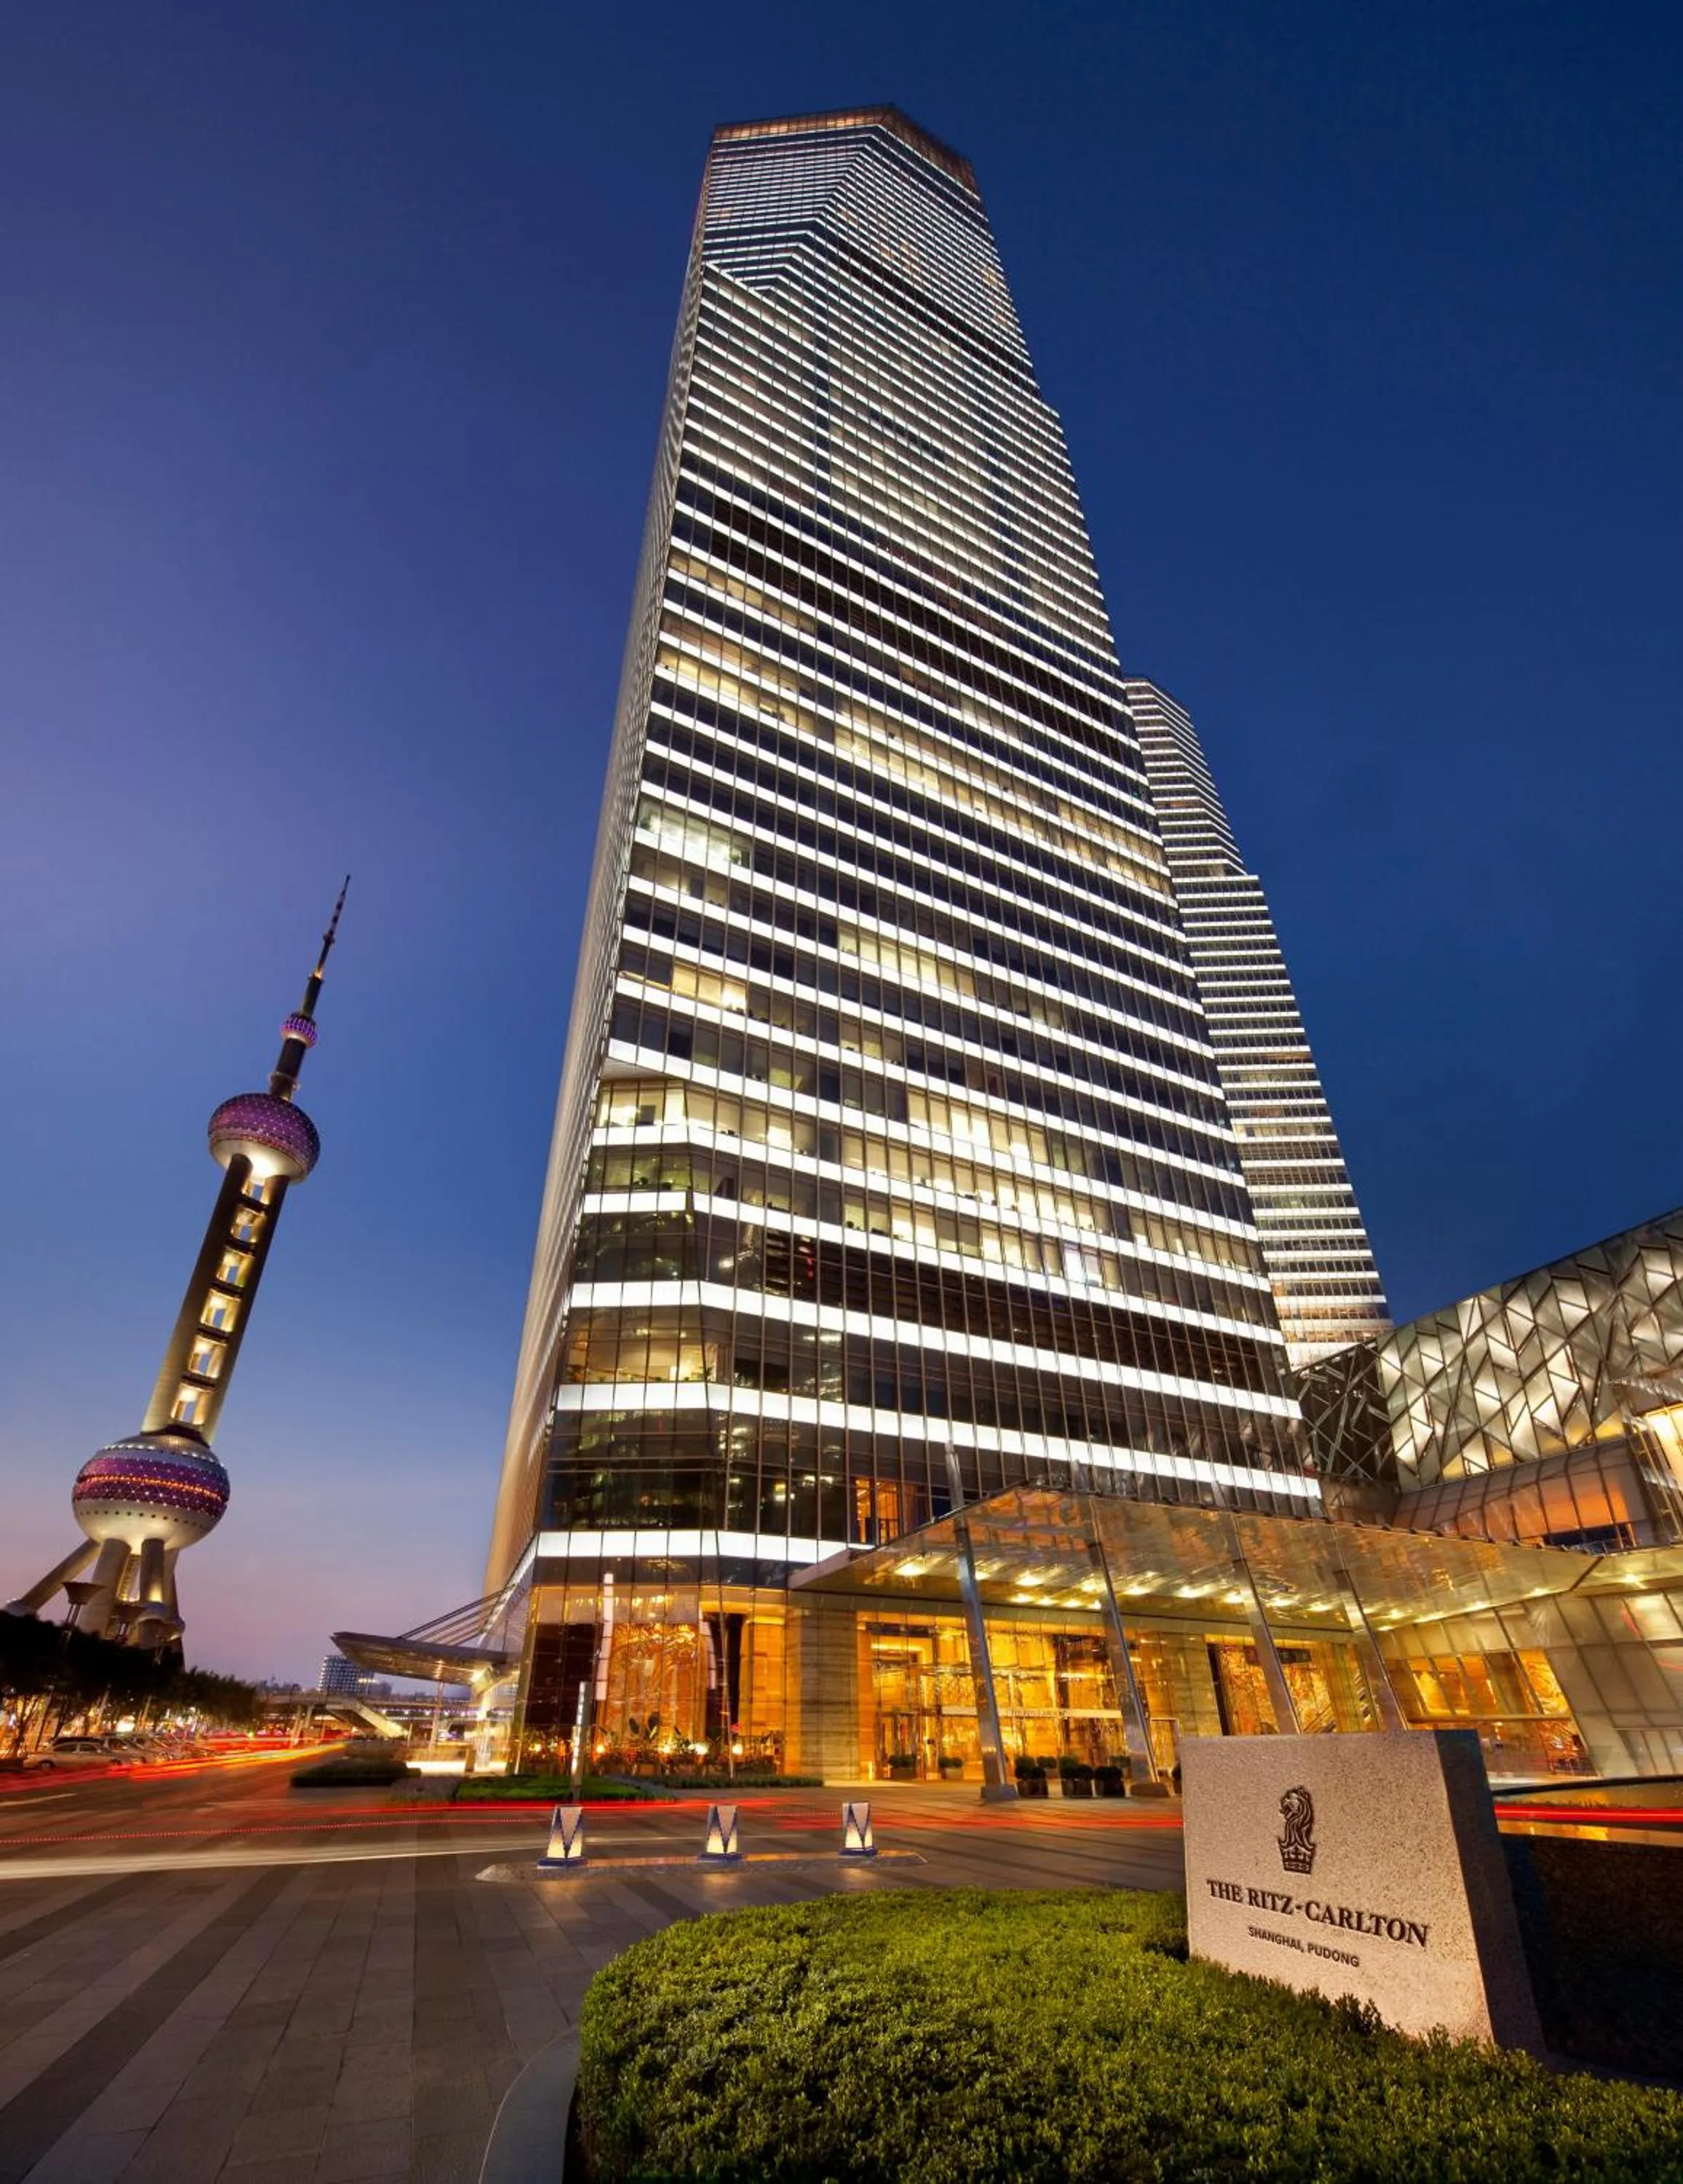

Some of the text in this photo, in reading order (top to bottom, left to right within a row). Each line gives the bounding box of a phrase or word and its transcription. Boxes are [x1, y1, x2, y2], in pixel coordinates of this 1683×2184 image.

[1206, 1879, 1429, 1947] THE RITZ-CARLTON
[1248, 1926, 1360, 1967] SHANGHAI, PUDONG
